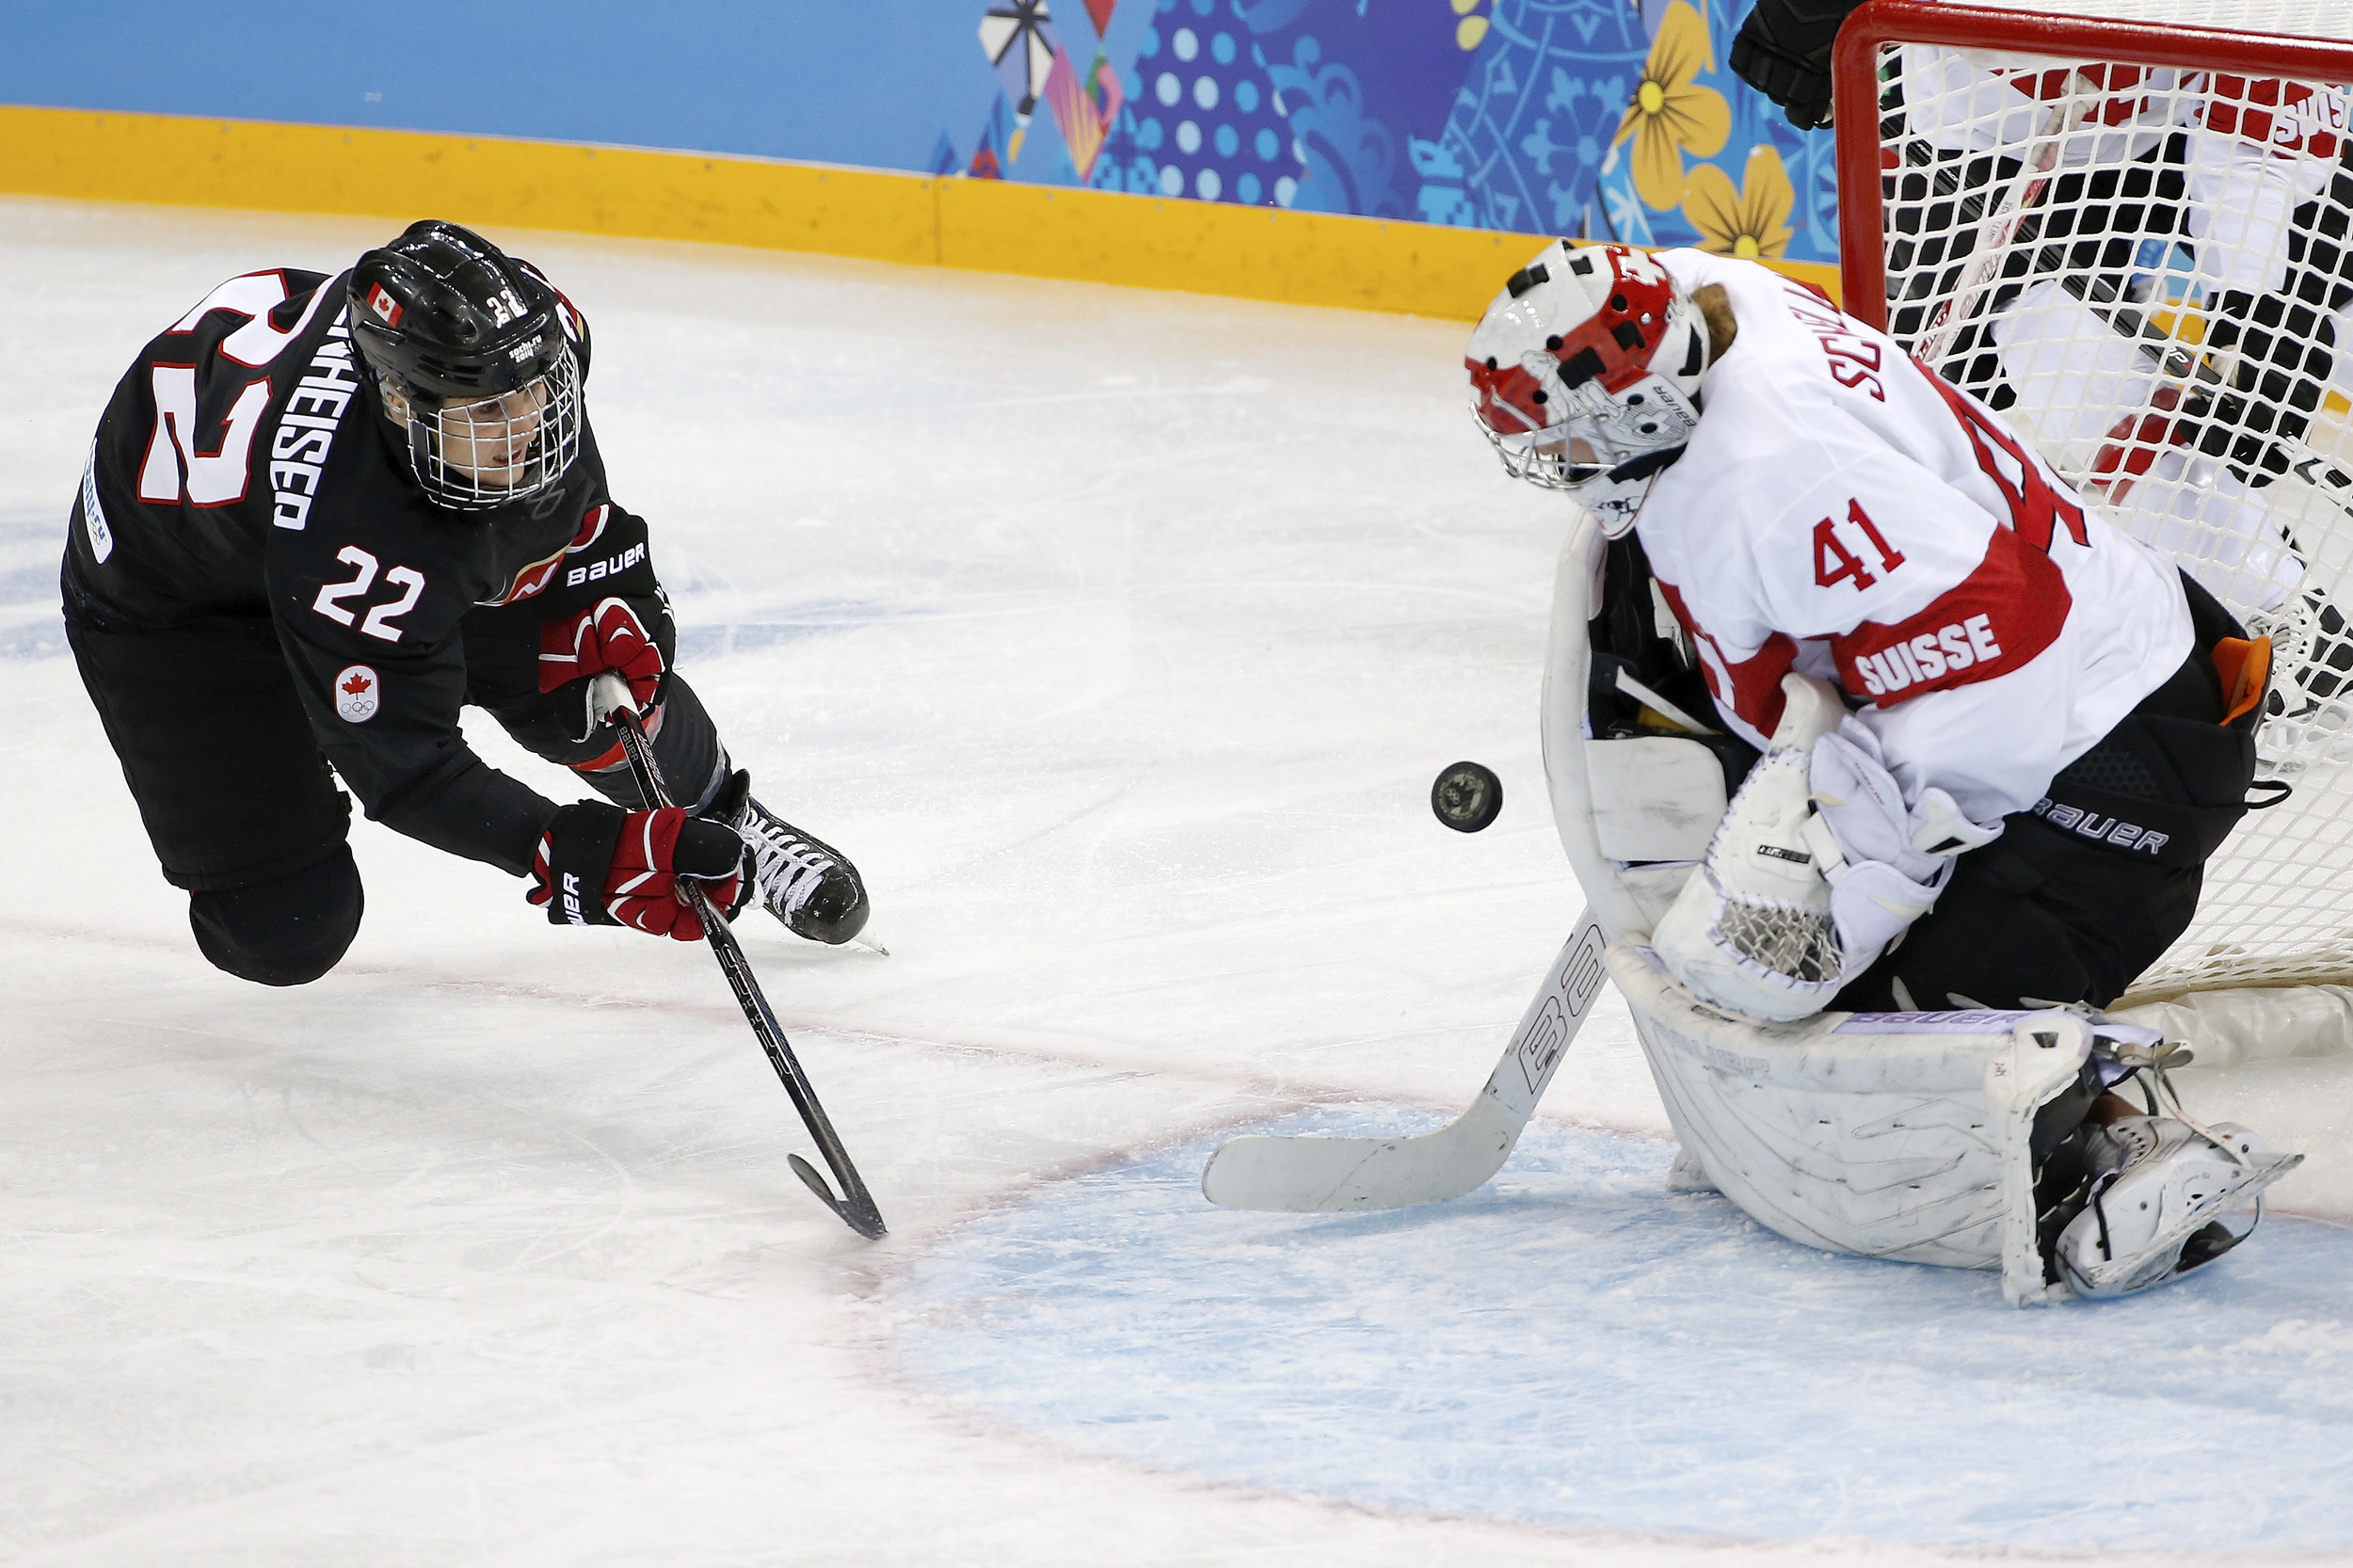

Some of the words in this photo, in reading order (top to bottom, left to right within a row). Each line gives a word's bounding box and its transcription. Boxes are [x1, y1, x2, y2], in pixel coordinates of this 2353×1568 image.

[486, 288, 528, 329] 22
[1813, 497, 1907, 592] 41
[312, 545, 427, 643] 22
[1854, 613, 2003, 696] SUISSE
